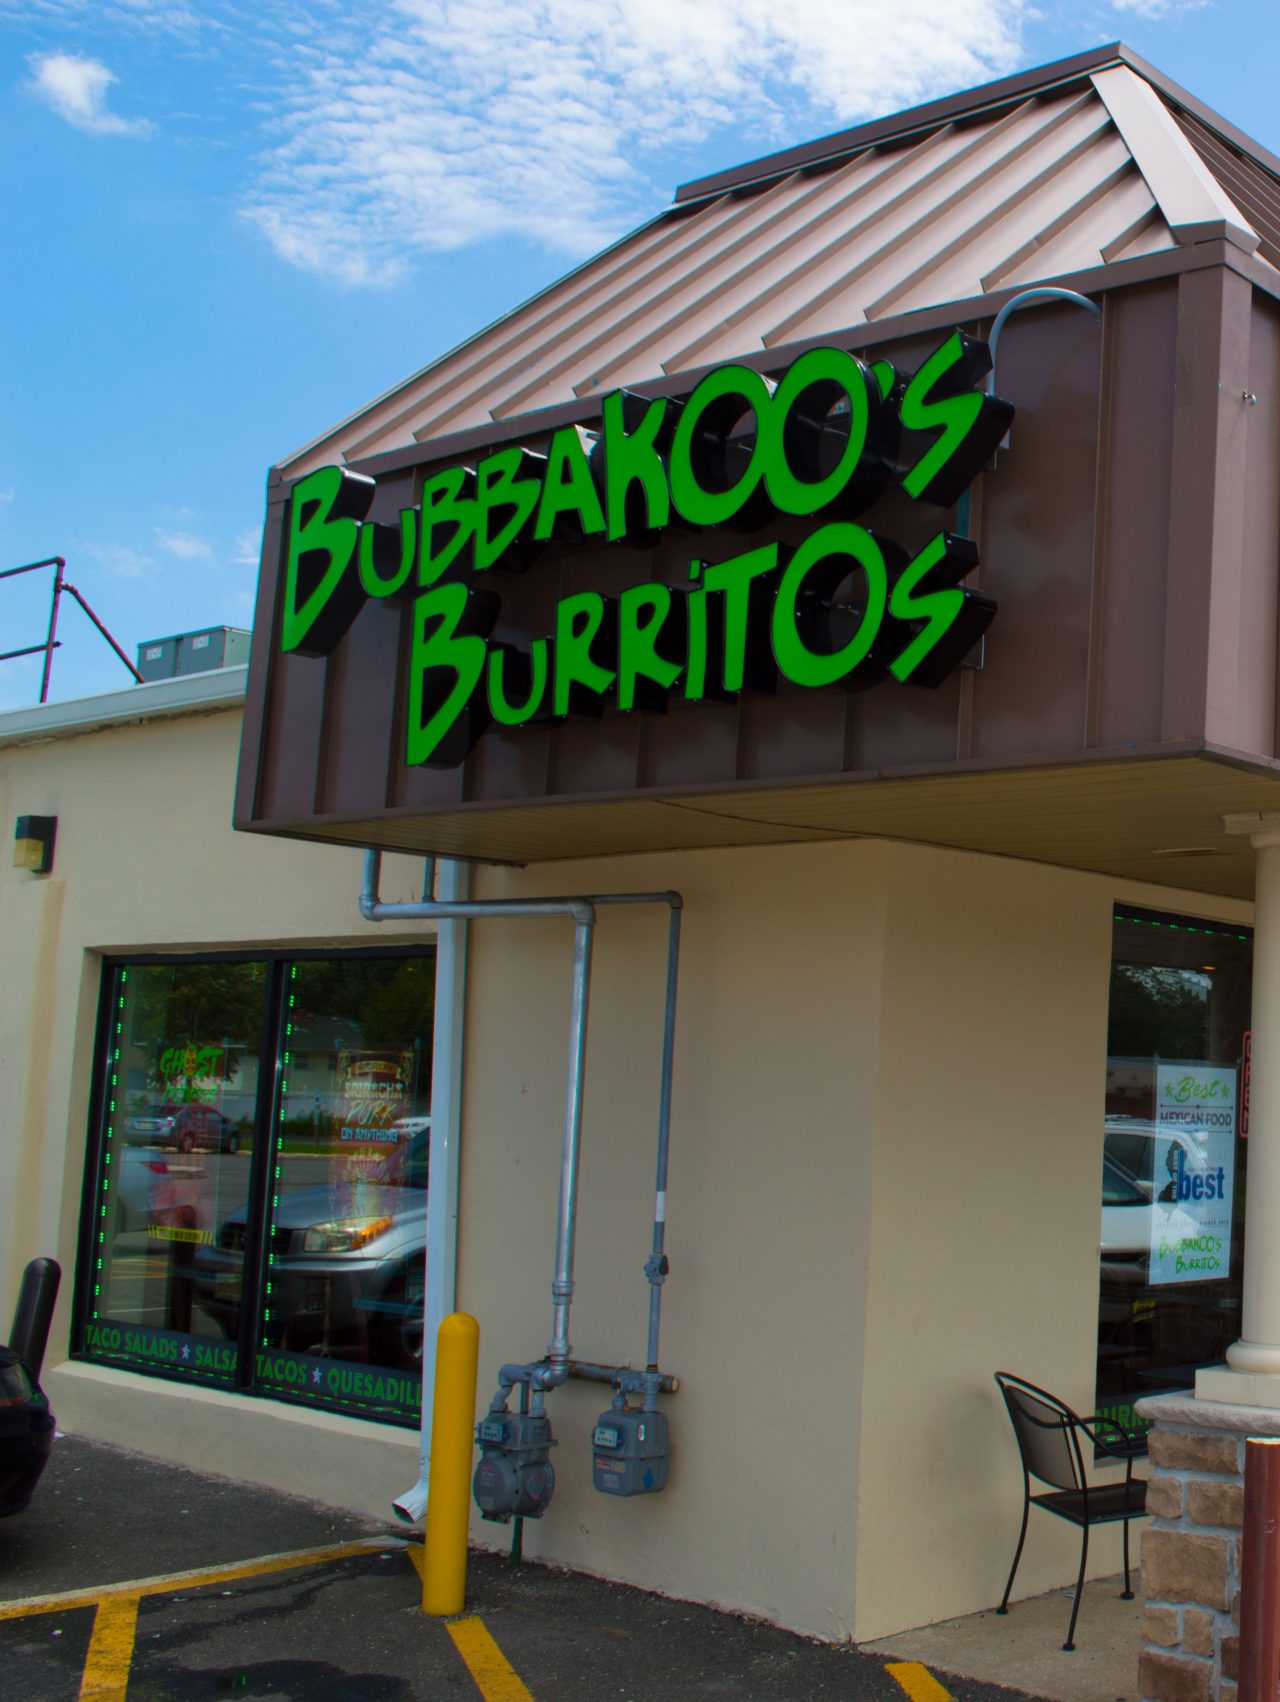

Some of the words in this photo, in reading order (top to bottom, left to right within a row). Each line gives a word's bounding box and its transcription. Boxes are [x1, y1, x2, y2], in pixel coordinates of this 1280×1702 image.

[282, 330, 988, 656] BUBBAKOO'S
[1174, 1076, 1220, 1103] Best
[346, 1100, 398, 1126] PORK
[1160, 1111, 1204, 1126] MEXICAN
[1206, 1112, 1233, 1127] FOOD
[1178, 1149, 1225, 1200] best
[86, 1324, 121, 1349] TACO
[125, 1331, 178, 1361] SALADS
[255, 1354, 308, 1385] TACOS
